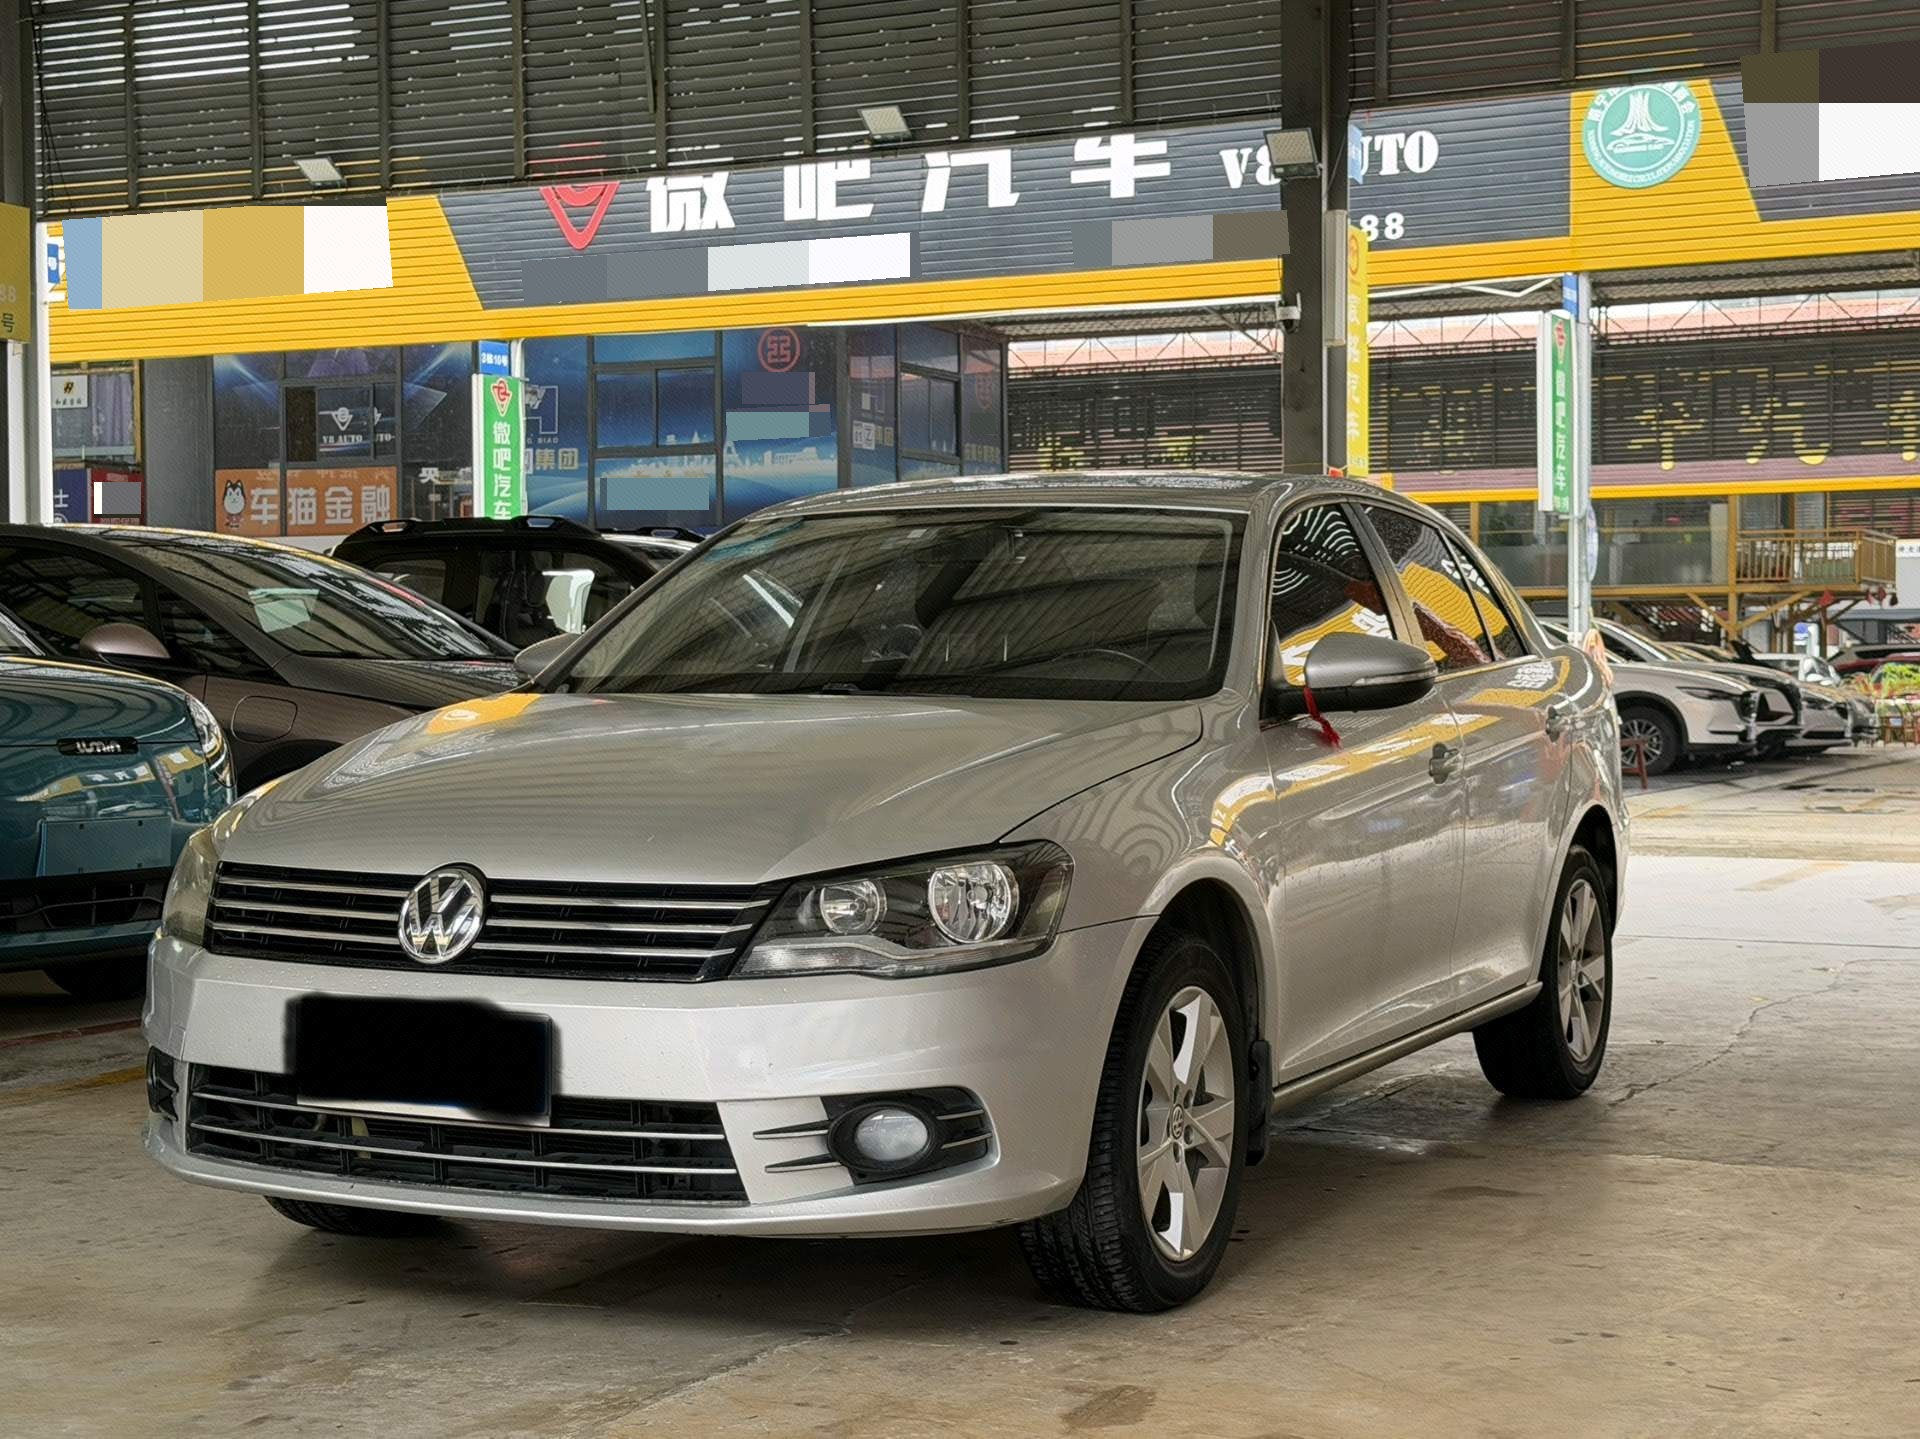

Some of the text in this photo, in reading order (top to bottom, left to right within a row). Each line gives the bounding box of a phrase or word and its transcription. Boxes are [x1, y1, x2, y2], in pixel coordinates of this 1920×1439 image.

[250, 484, 391, 525] 车猫金融
[492, 421, 512, 519] 微吧汽车
